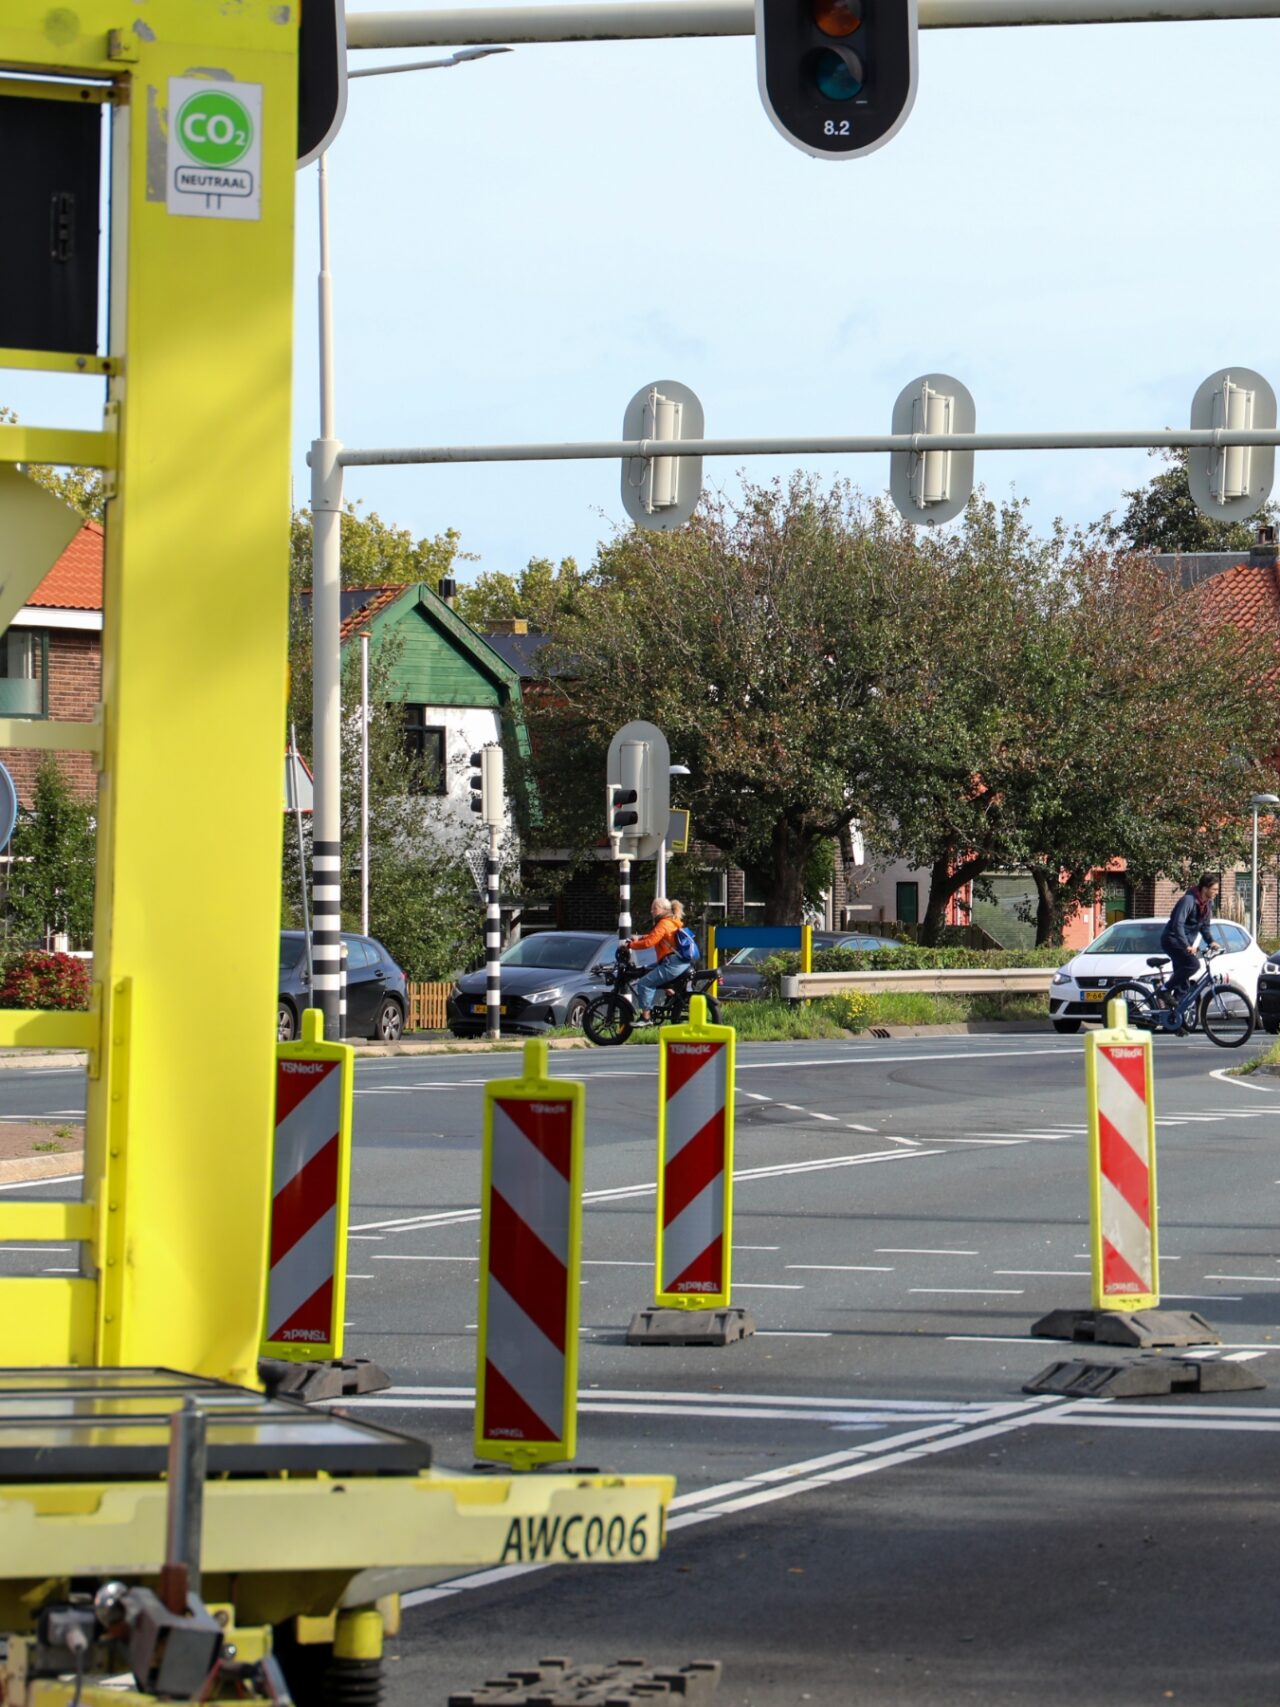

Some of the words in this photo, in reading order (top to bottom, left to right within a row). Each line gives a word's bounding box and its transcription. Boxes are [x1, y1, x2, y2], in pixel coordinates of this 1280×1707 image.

[823, 120, 850, 136] 8.2
[180, 174, 247, 189] NEUTRAAL
[500, 1513, 648, 1561] AWC006
